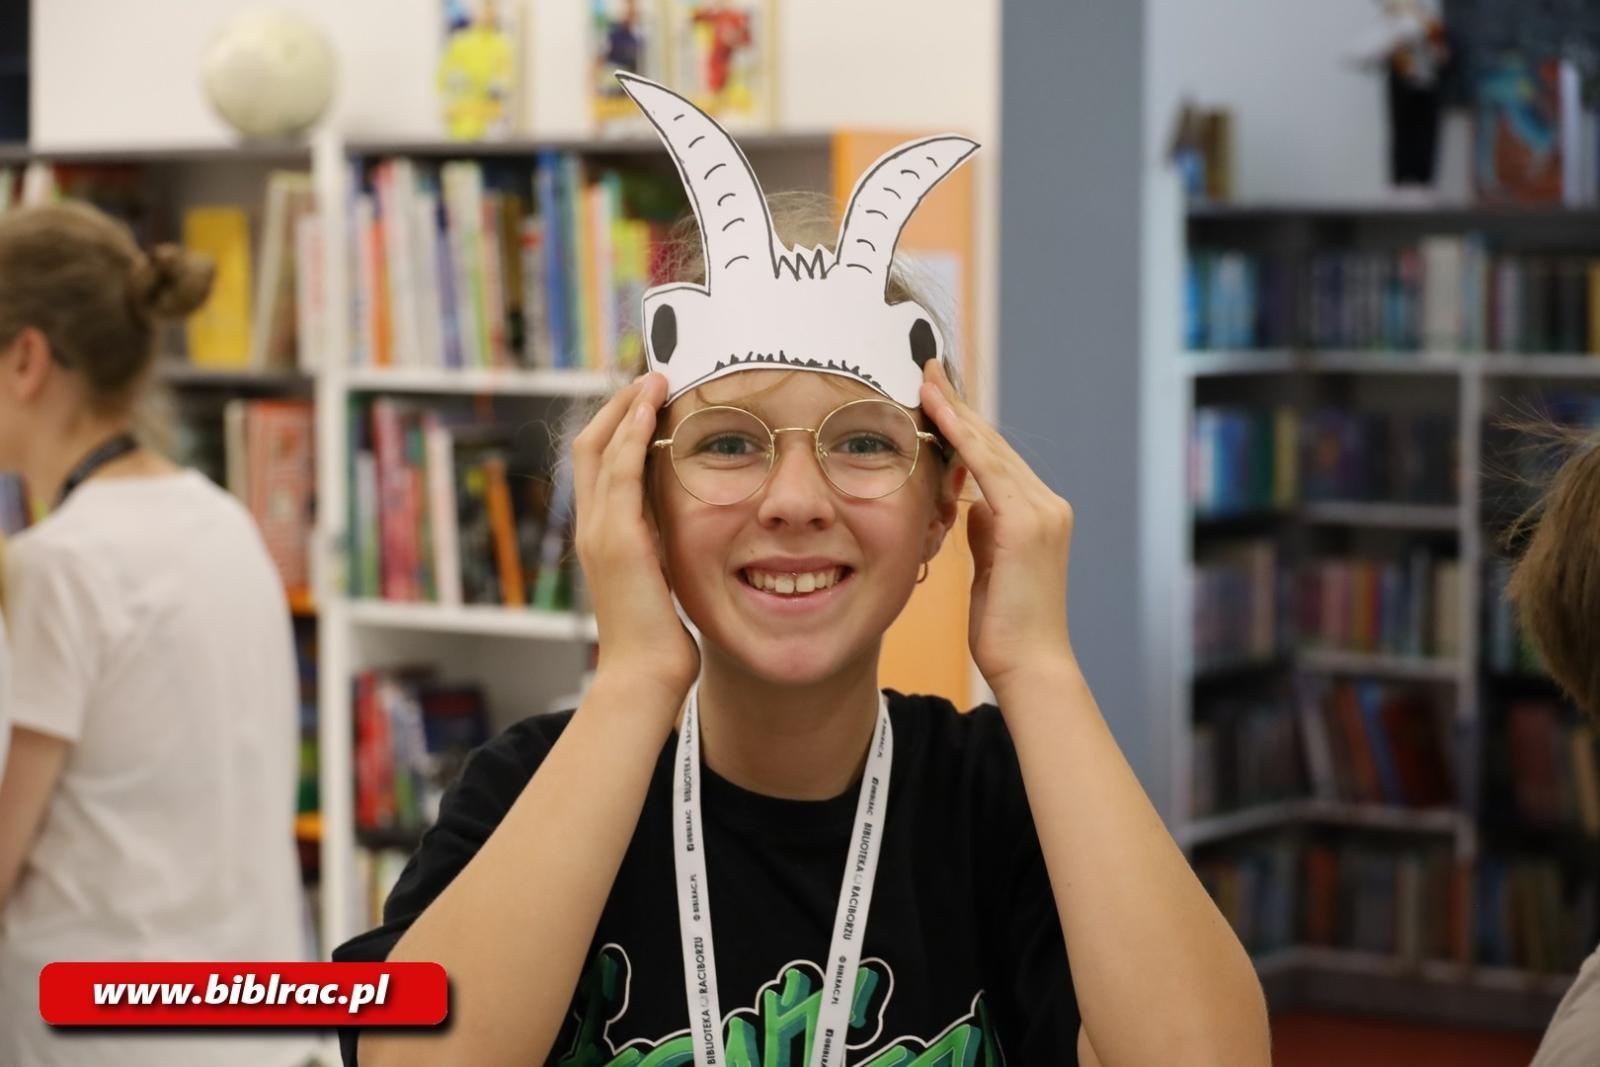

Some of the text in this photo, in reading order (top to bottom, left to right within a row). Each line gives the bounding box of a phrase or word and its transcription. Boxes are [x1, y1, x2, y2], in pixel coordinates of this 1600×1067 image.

[856, 822, 873, 873] BIBLIOTEKA
[842, 885, 861, 941] RACIBORZU
[694, 937, 716, 1065] BIBLIOTEKA RACIBORZU
[831, 964, 845, 1005] BIBLRAC.PL
